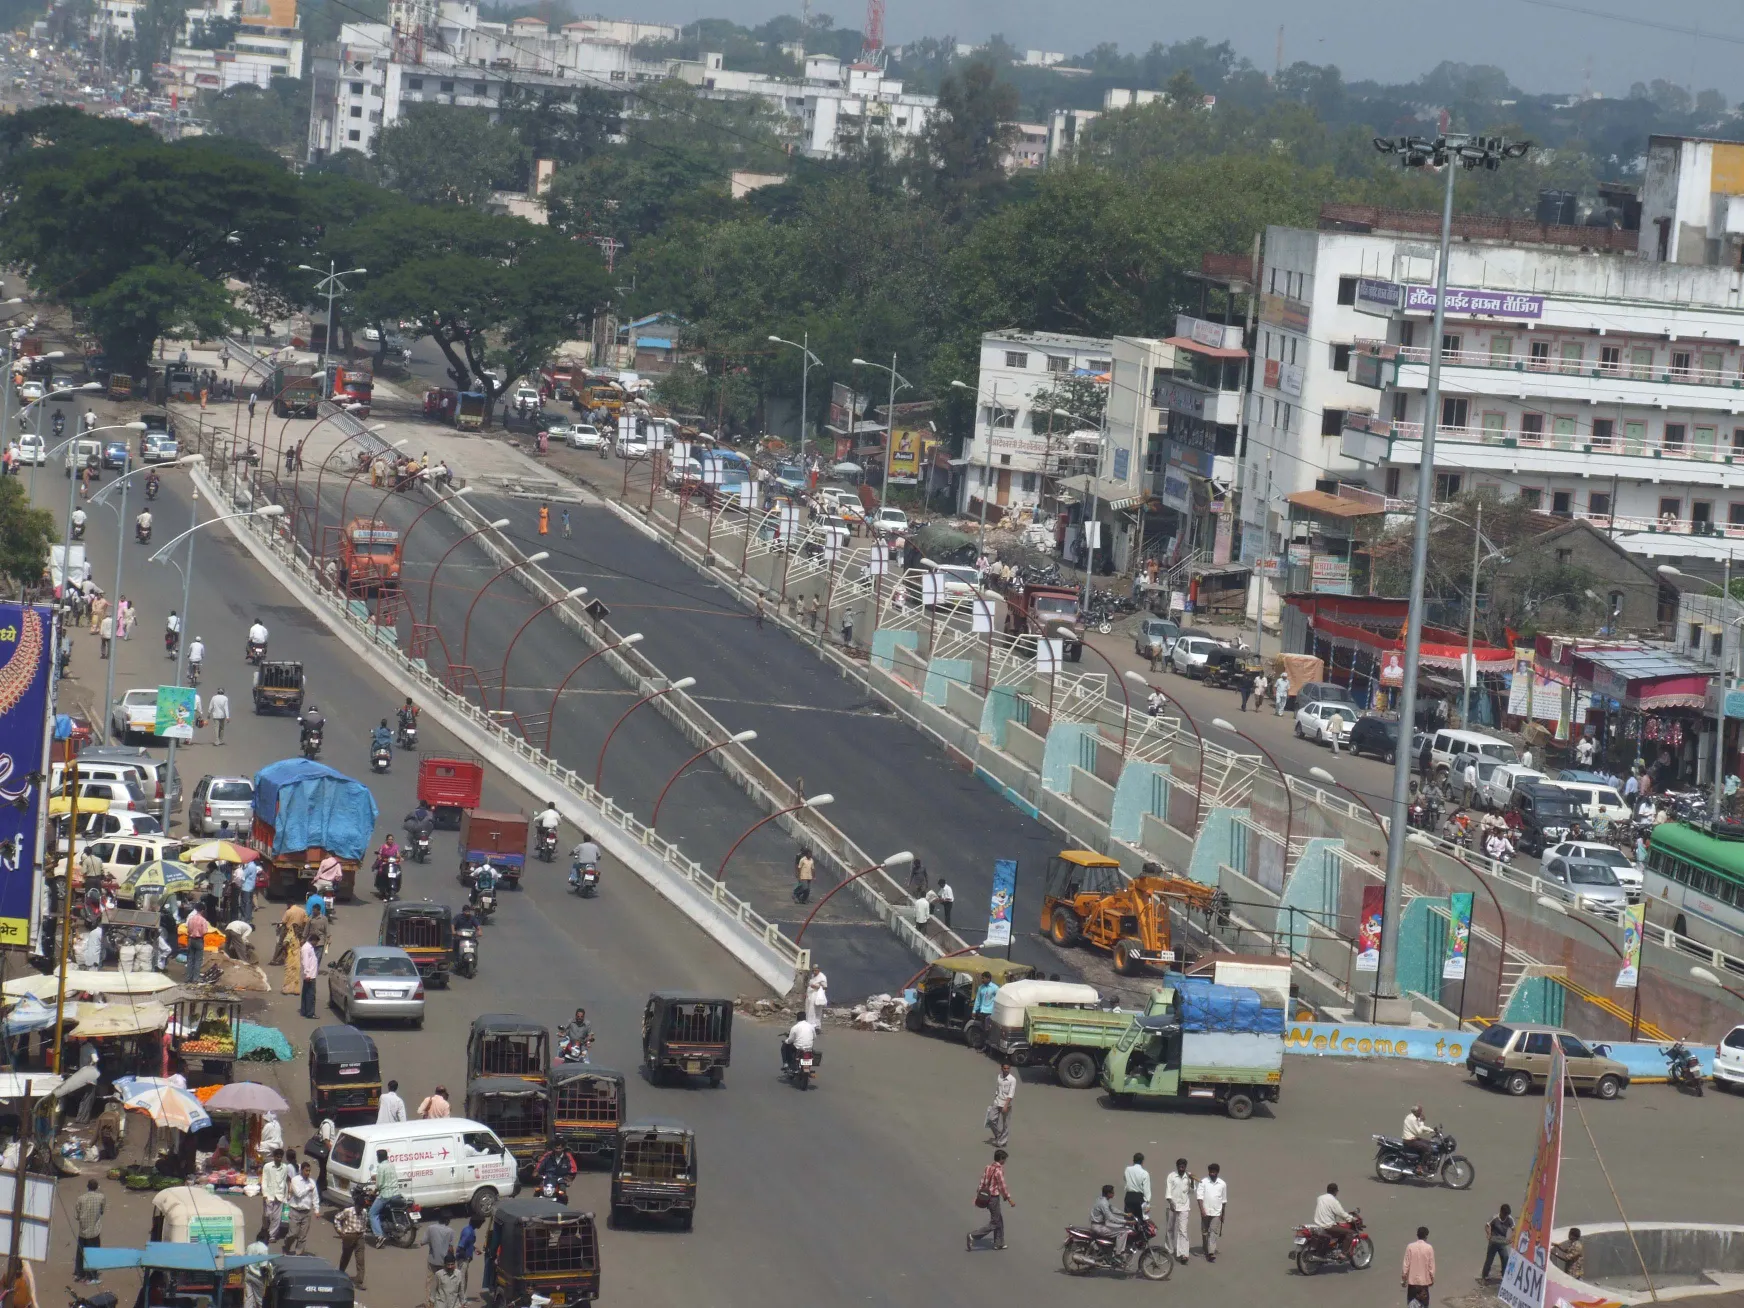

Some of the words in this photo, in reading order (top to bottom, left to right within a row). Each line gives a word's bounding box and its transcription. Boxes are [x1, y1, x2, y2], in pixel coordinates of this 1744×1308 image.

[1284, 1027, 1408, 1056] Welcome
[1435, 1037, 1463, 1058] to
[1513, 1261, 1544, 1302] ASM
